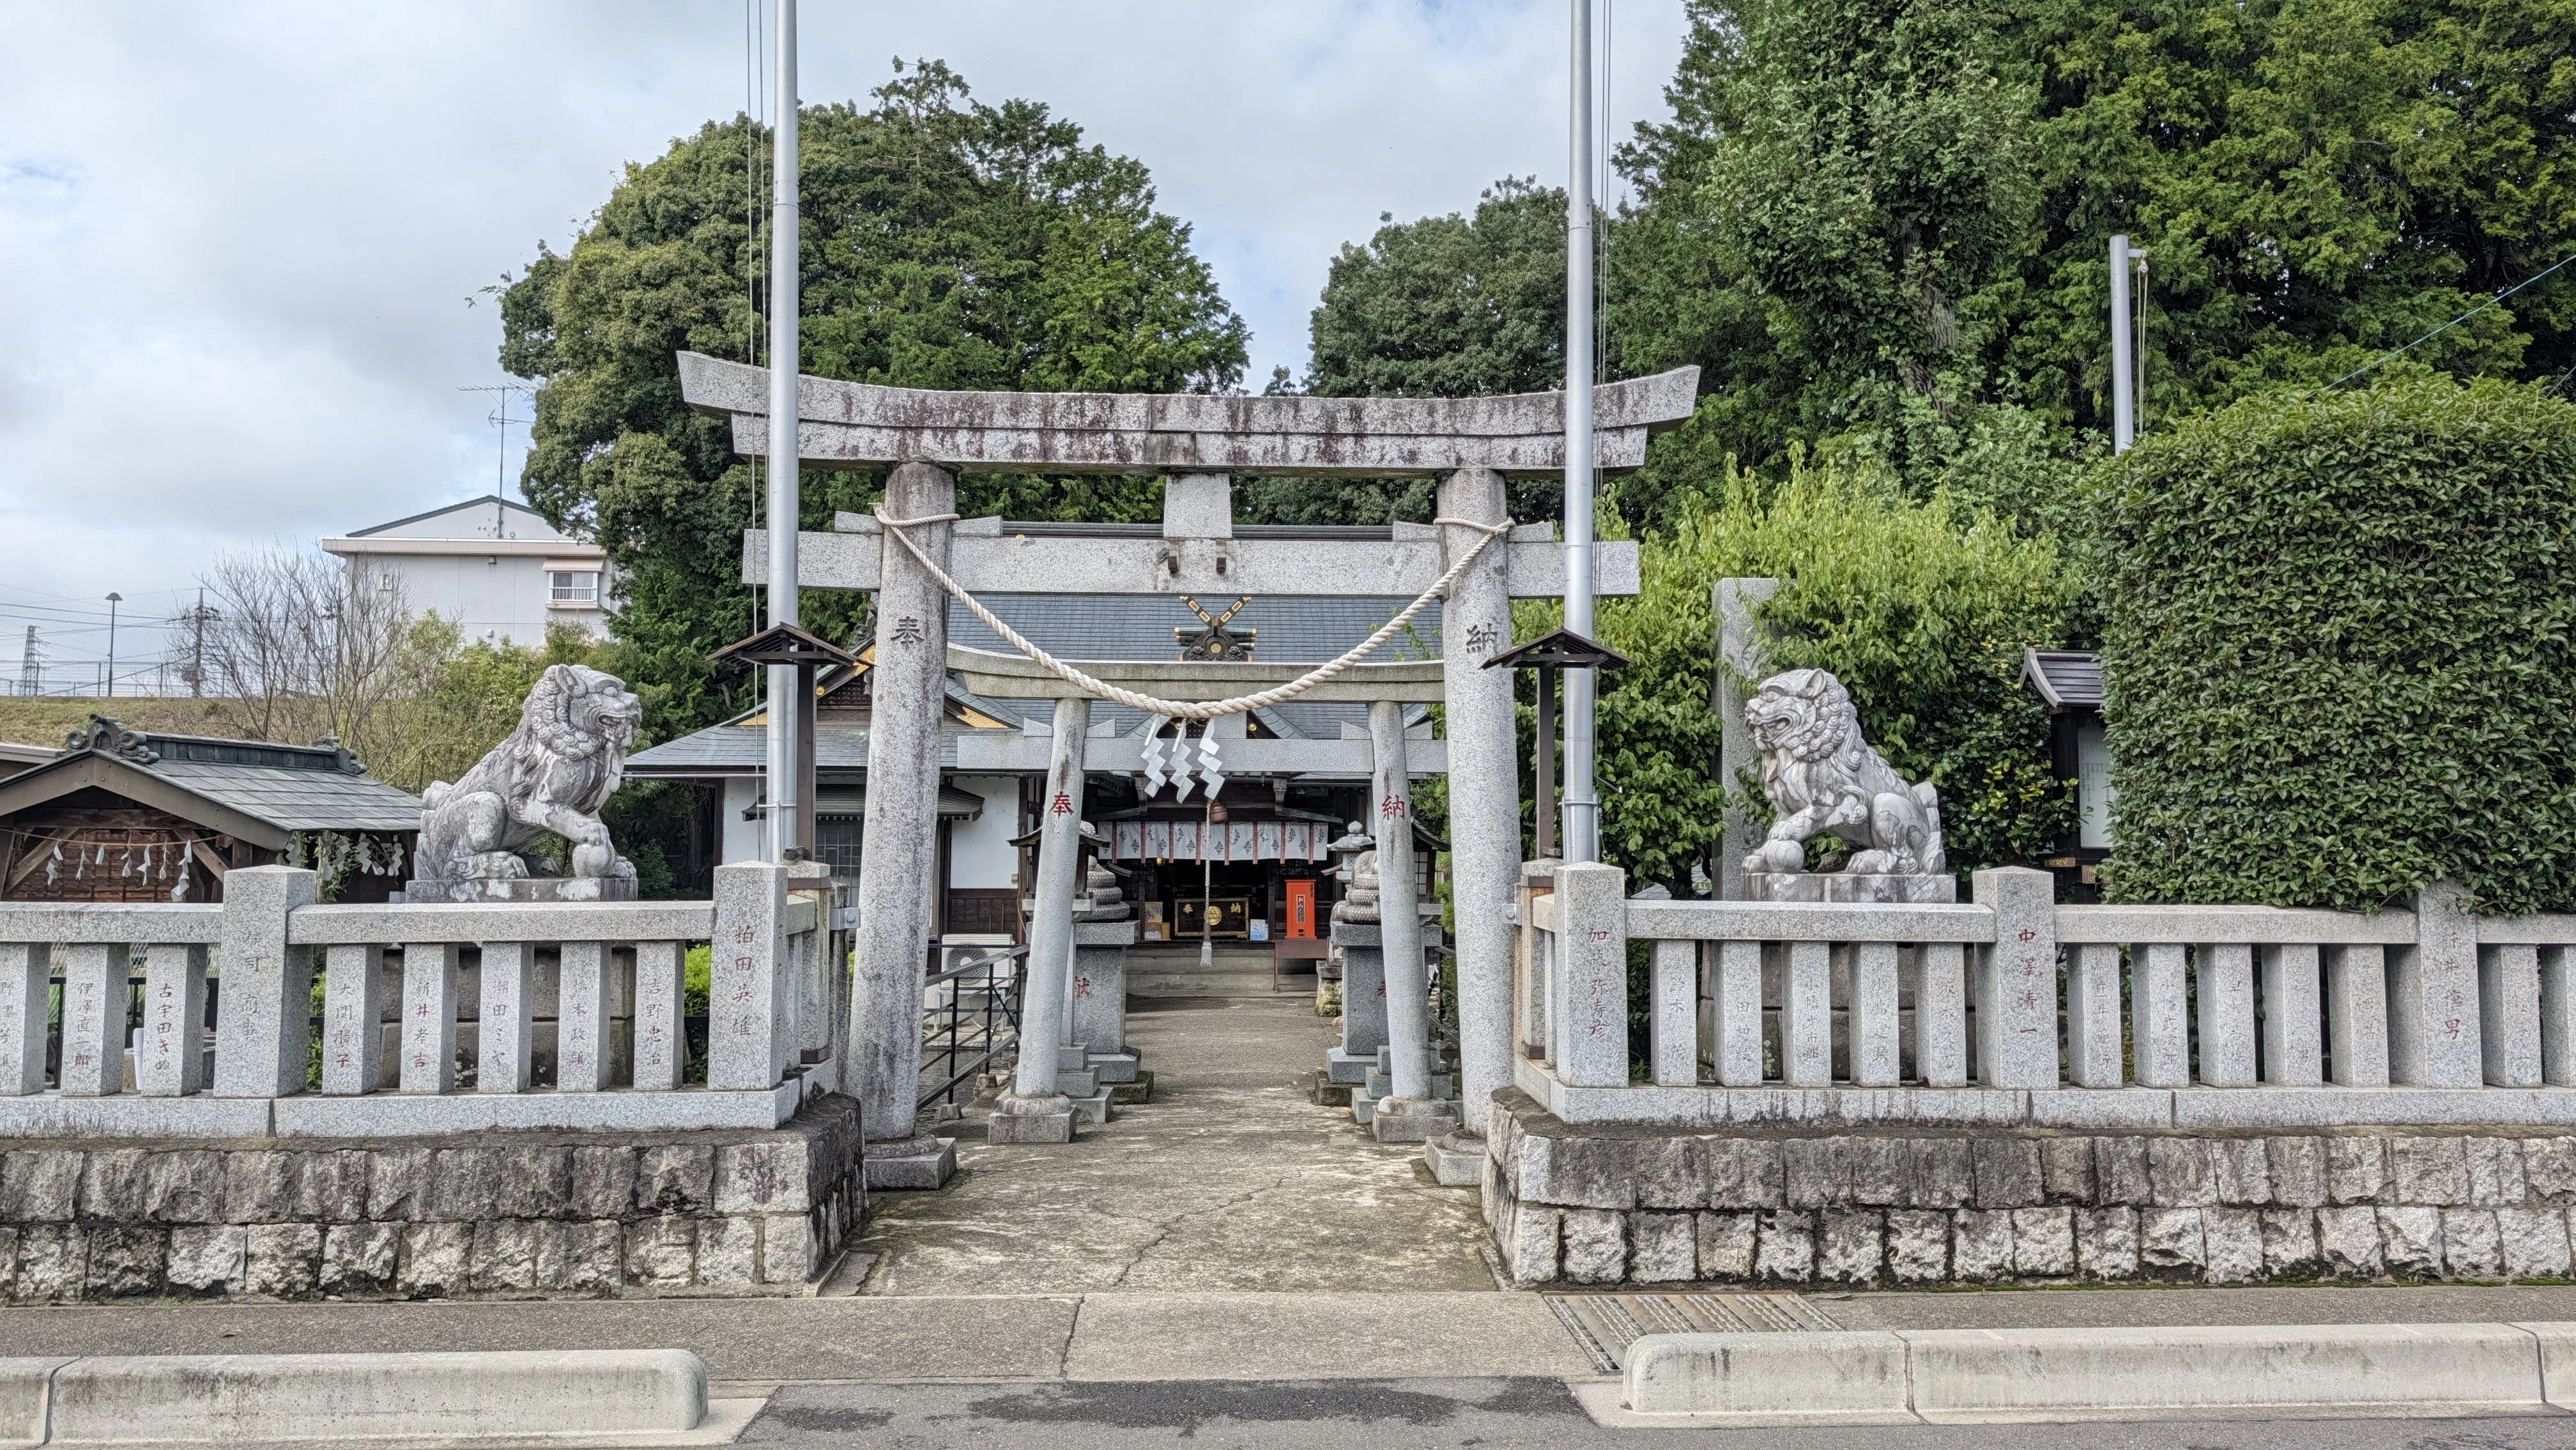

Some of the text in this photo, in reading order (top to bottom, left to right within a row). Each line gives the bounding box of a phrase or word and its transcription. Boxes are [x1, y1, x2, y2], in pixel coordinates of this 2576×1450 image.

[891, 616, 925, 650] 奉
[1466, 623, 1498, 653] 納
[1049, 791, 1075, 818] 奉
[1382, 795, 1405, 821] 納
[1183, 903, 1241, 914] 奉 納
[570, 979, 587, 1064] 橋本政雄
[646, 978, 663, 1065] 吉野忠治
[733, 924, 755, 1036] 柏田英雄
[2019, 929, 2038, 1034] 中澤清一
[154, 983, 172, 1071] 古宇田きぬ
[334, 983, 353, 1068] 大関勝子
[413, 982, 431, 1067] 新井孝吉
[492, 981, 509, 1067] 潮田ミヤ
